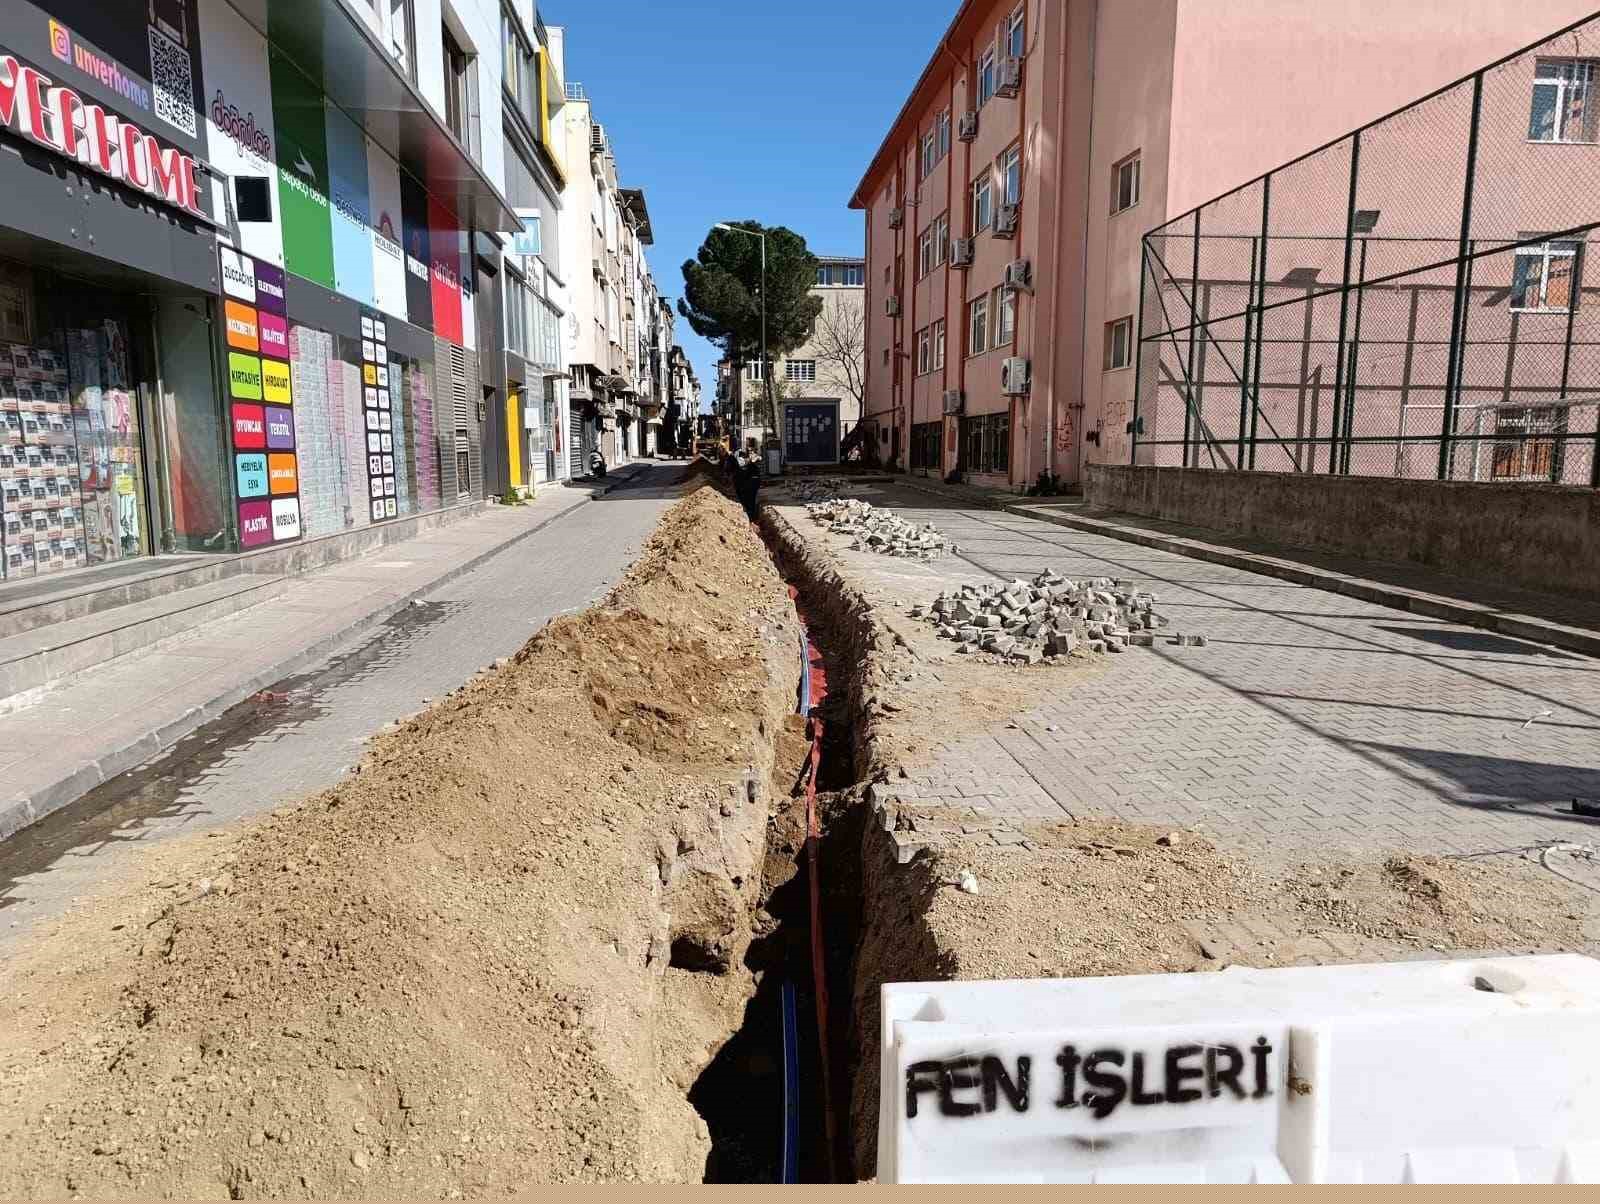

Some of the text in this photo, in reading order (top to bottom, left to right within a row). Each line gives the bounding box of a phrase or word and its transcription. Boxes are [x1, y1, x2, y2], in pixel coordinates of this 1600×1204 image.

[74, 43, 149, 111] unverhome
[265, 375, 288, 390] HIRDAVAT
[236, 419, 262, 433] OYUNCAK
[244, 514, 267, 532] PLASTİK
[906, 1036, 1273, 1119] FEN İŞLERİ
